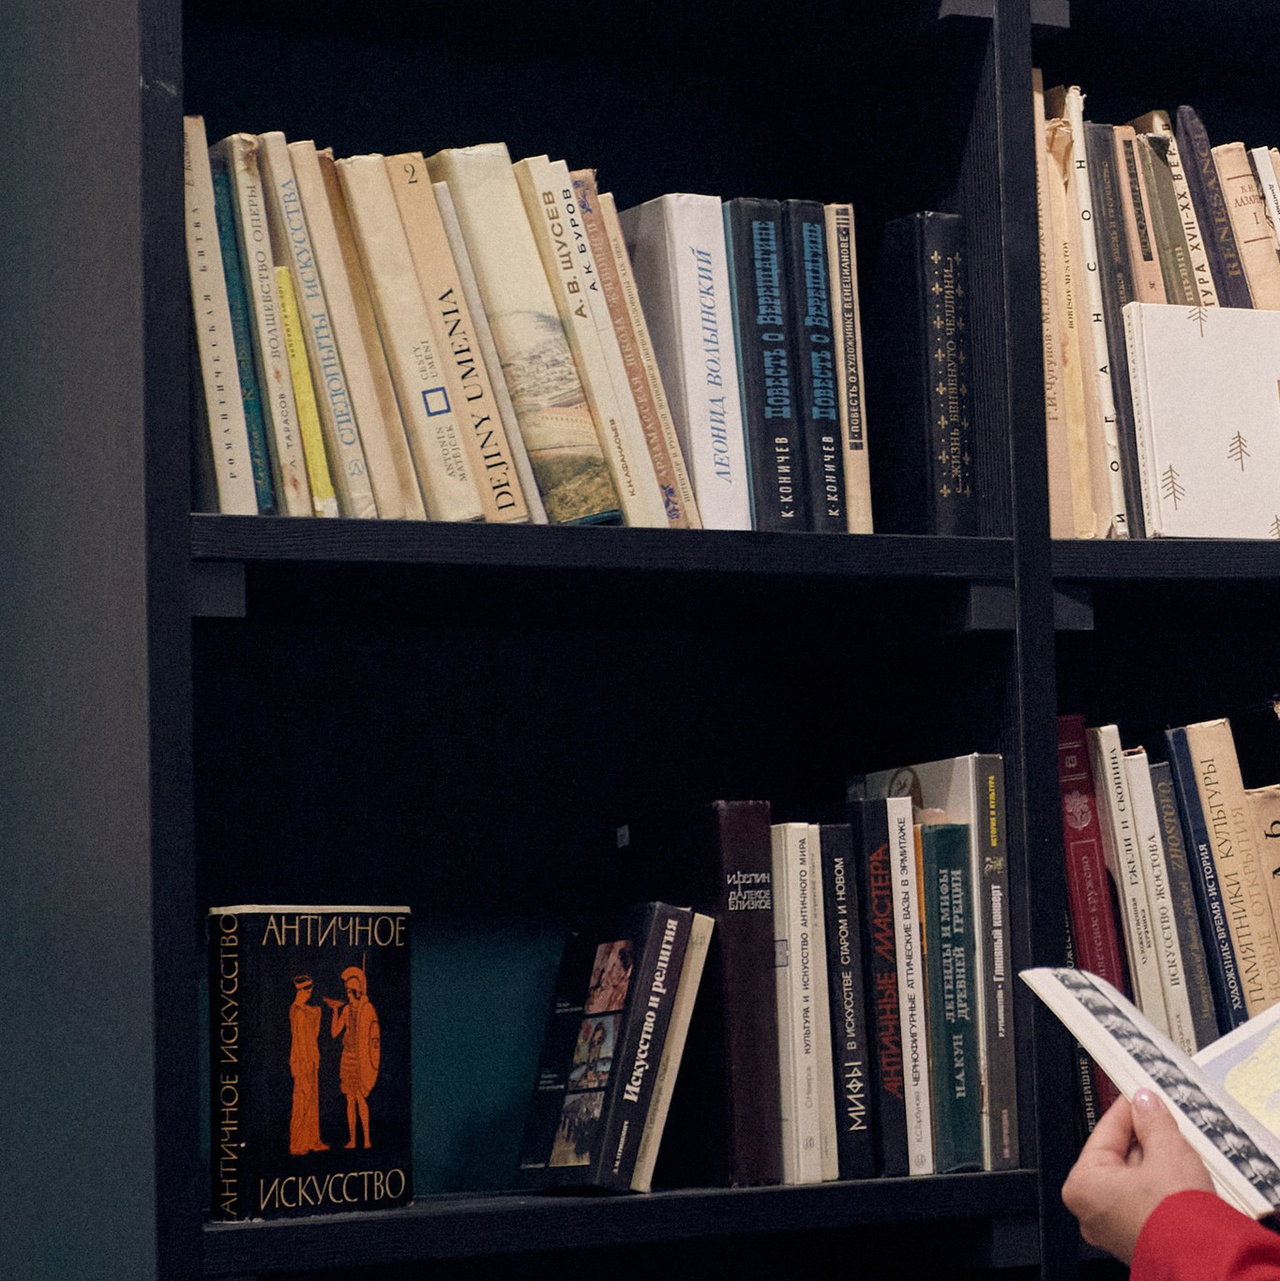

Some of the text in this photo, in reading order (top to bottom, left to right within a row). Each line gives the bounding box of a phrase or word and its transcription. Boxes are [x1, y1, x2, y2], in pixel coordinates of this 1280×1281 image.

[404, 163, 418, 185] 2
[562, 188, 586, 253] БУРОВ
[245, 184, 280, 358] ВОЛШЕБСТВО ОПЕРЫ
[543, 190, 574, 271] ЩУСЕВ
[586, 222, 617, 306] ЖИВОПИСИ
[752, 220, 783, 325] ВЕРЕЩАГИНЕ
[802, 223, 828, 327] ВЕРЕЩАГИНЕ
[840, 237, 851, 308] ВЕНЕЦИАНОВЕ
[192, 207, 237, 478] РОМАНТИЧЕСКАЯ БИТВА
[279, 178, 356, 446] СЛЕДОПЫТЫ ИСКУССТВА
[690, 237, 731, 483] ЛЕОНИД ВОЛЫНСКИЙ
[438, 288, 516, 511] DEJINY UMENIA
[946, 341, 958, 421] БЕНВЕНУТО
[1108, 748, 1126, 812] СКОПИНА
[1157, 781, 1185, 870] ZHOSTOVO
[1147, 834, 1180, 986] ИСКУССТВО ЖОСТОВА
[1200, 758, 1266, 1002] ПАМЯТНИКИ КУЛЬТУРЫ
[1231, 805, 1262, 917] ОТКРЫТИЯ
[262, 915, 406, 947] АНТИЧНОЕ
[870, 842, 903, 1098] АНТИЧНЫЕ МАСТЕРА
[938, 868, 957, 1023] ЛЕГЕНДЫ МИФЫ
[950, 869, 970, 1020] ДРЕВНЕЙ ГРЕЦИИ
[622, 918, 678, 1102] Искусство религия
[834, 857, 867, 1130] МИФЫ ИСКУССТВЕ СТАРОМ НОВОМ
[907, 994, 920, 1085] ЧЕРНОФИГУРНЫЕ
[220, 913, 239, 1216] АНТИЧНОЕ ИСКУССТВО
[260, 1168, 405, 1211] ИСКУССТВО
